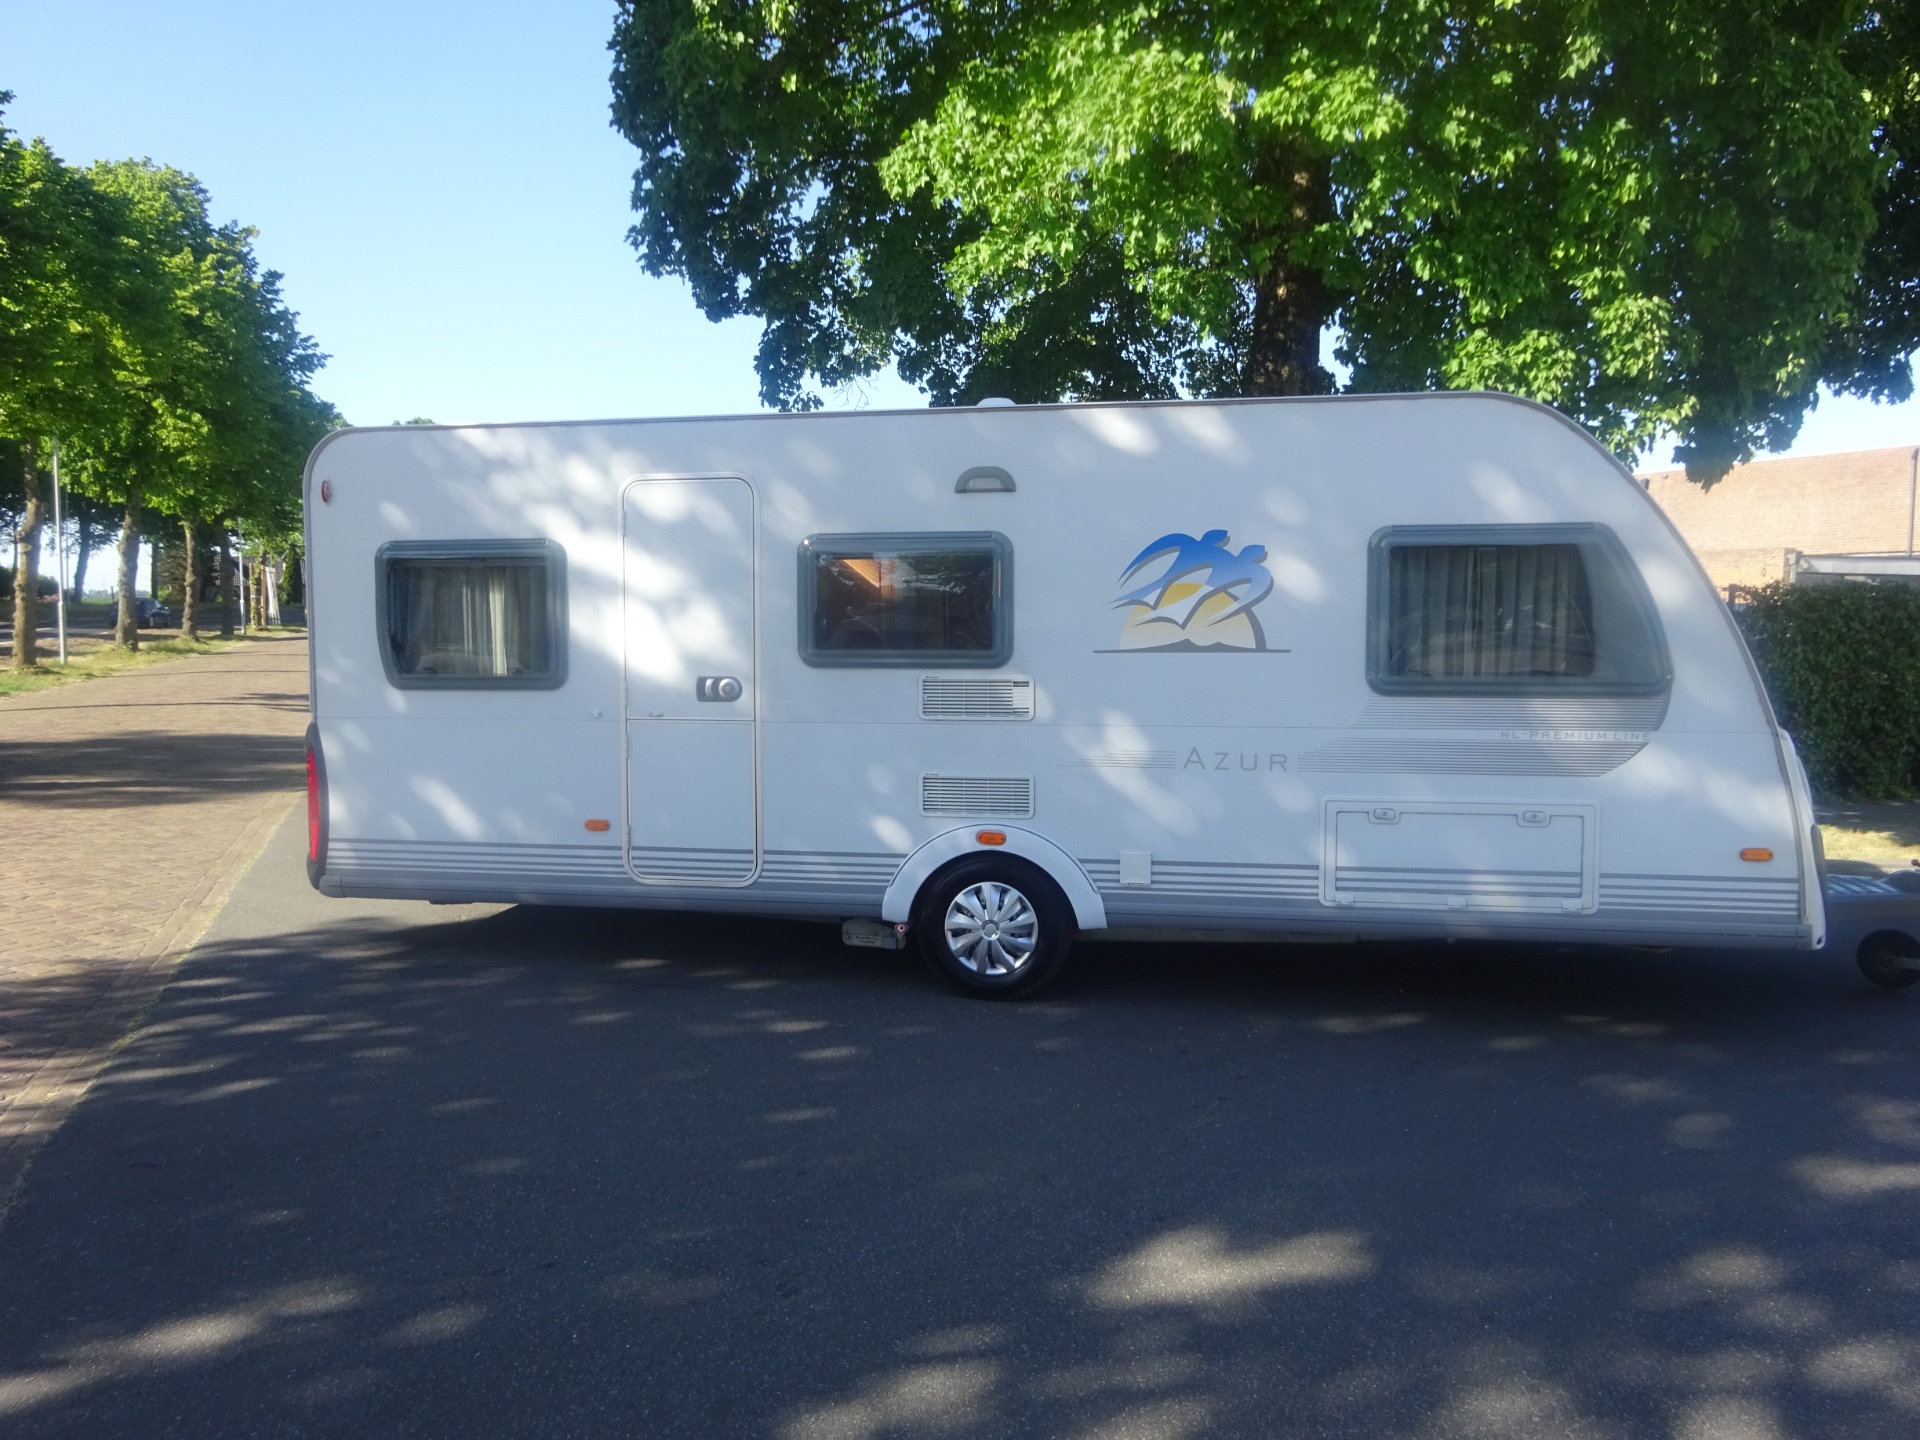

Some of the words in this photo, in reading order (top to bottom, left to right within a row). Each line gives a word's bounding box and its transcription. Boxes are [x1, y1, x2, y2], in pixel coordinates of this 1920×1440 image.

[1500, 730, 1607, 742] NL-PREMIUM
[1613, 731, 1652, 742] LINE
[1182, 746, 1289, 772] AZUR
